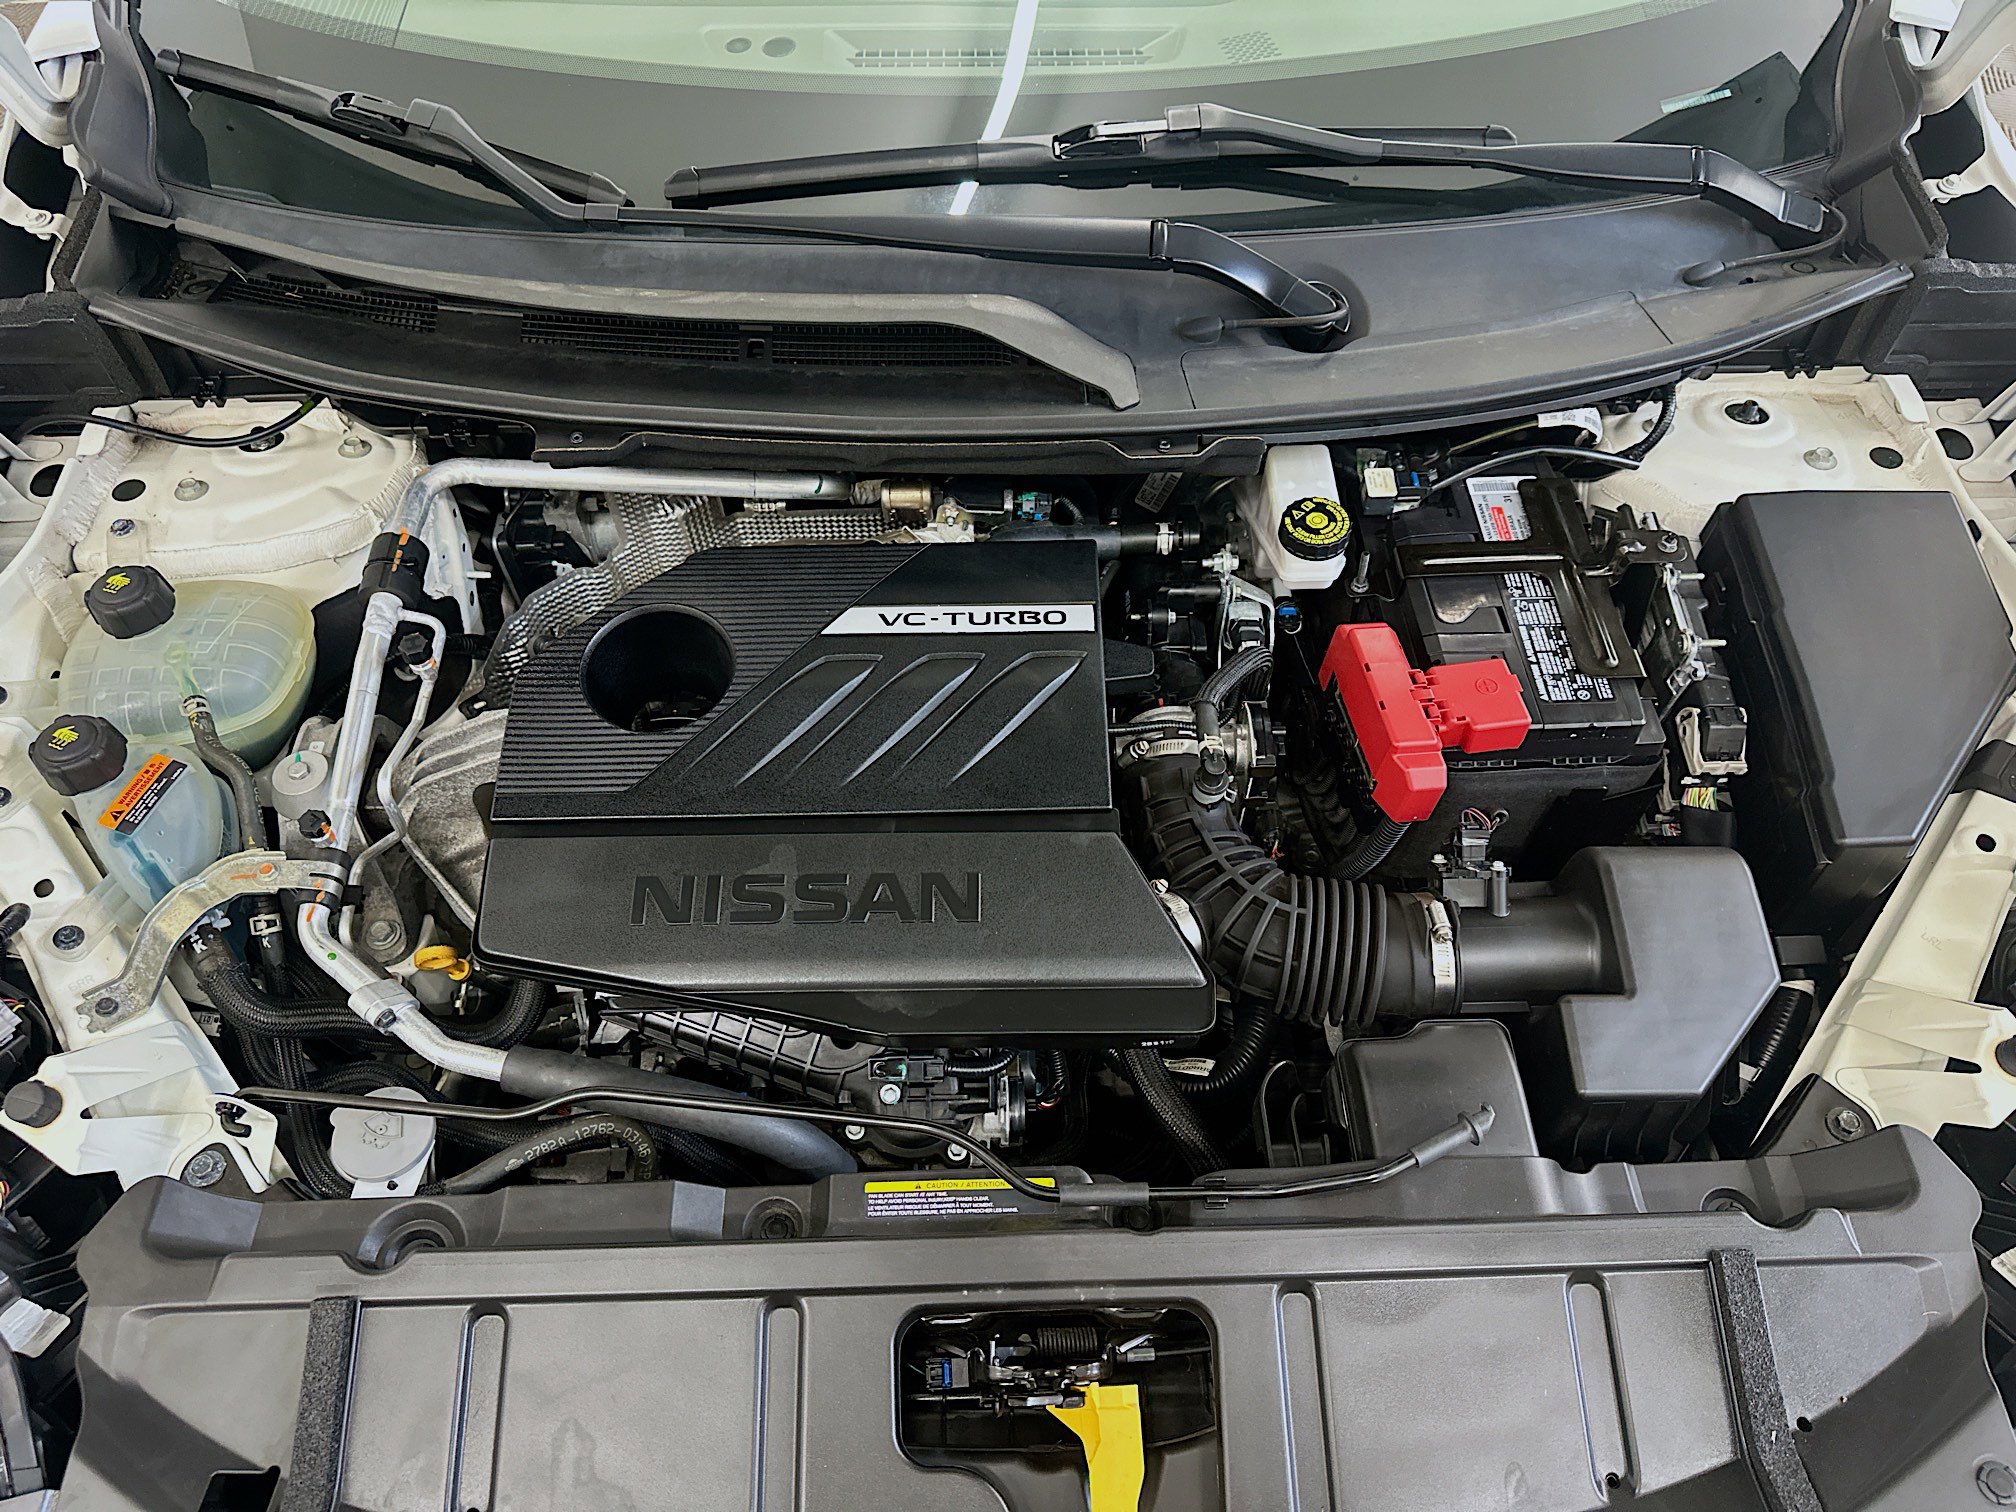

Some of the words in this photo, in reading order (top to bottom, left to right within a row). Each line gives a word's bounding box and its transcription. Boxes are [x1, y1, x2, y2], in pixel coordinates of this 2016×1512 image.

[878, 610, 1067, 626] VC-TURBO
[125, 762, 165, 808] AVERTISSEMENT
[630, 873, 982, 926] NISSAN
[262, 936, 272, 948] K
